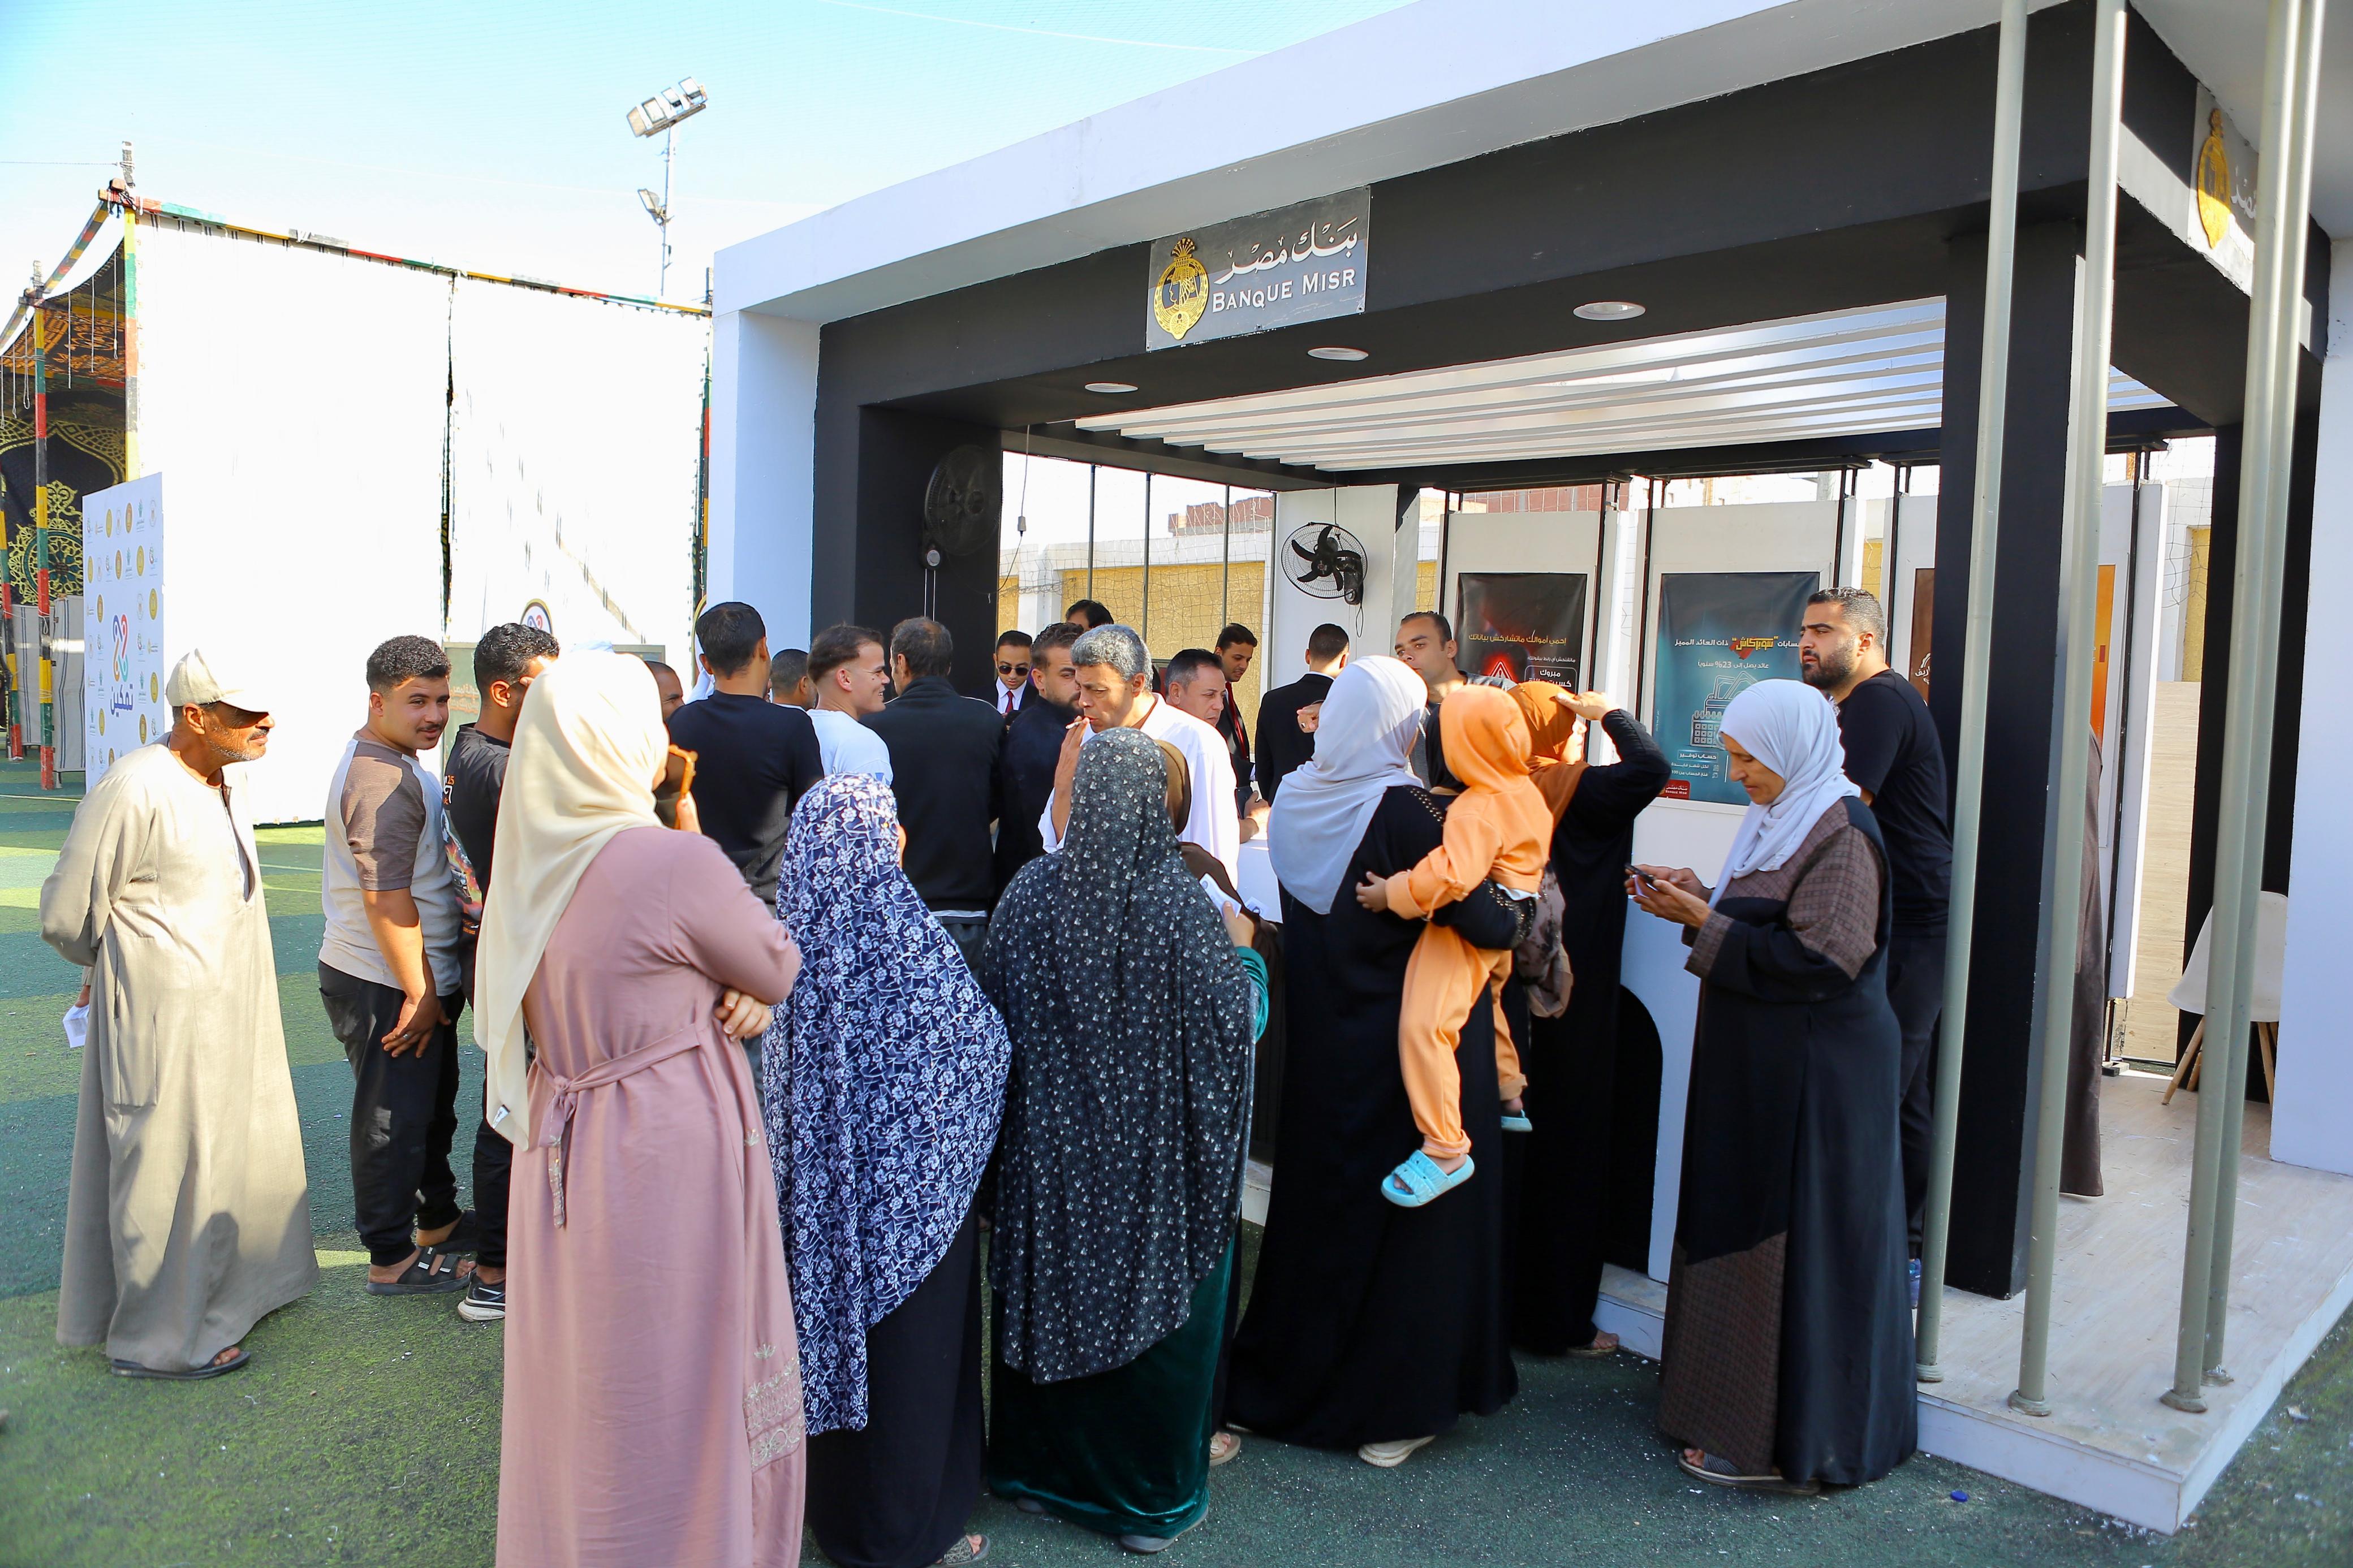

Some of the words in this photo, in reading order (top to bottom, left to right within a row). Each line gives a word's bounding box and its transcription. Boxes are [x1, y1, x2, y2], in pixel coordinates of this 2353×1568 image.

[1212, 280, 1293, 313] BANQUE
[1302, 268, 1356, 296] MISR
[110, 684, 133, 718] تمكين
